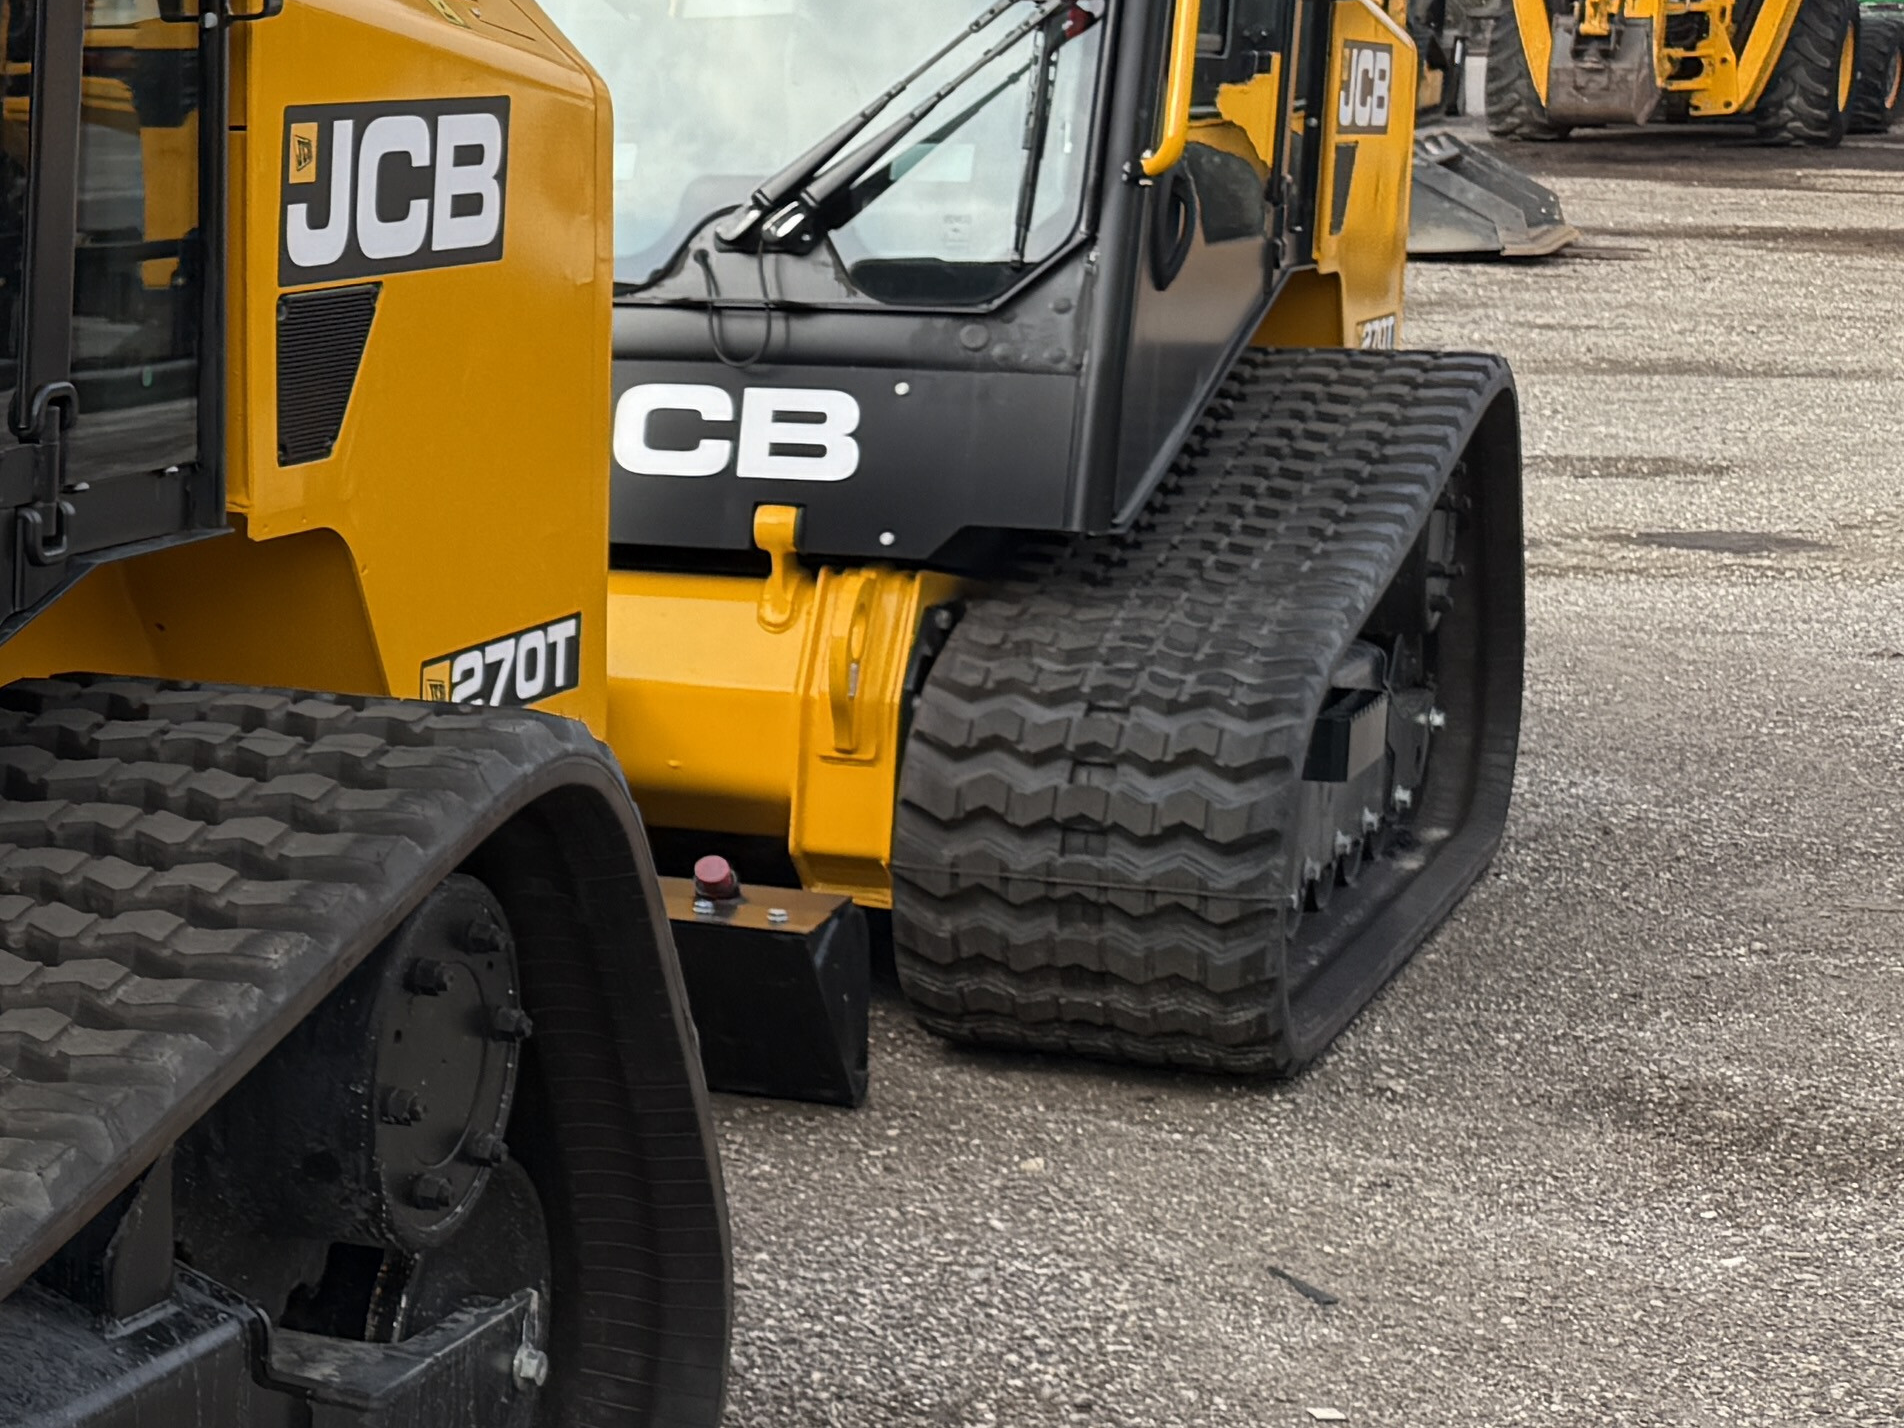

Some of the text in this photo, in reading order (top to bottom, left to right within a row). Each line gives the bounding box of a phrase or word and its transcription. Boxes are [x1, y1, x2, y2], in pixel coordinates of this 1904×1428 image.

[1339, 49, 1390, 126] JCB
[286, 113, 501, 267] JCB
[613, 383, 860, 481] CB
[451, 619, 576, 707] 270T
